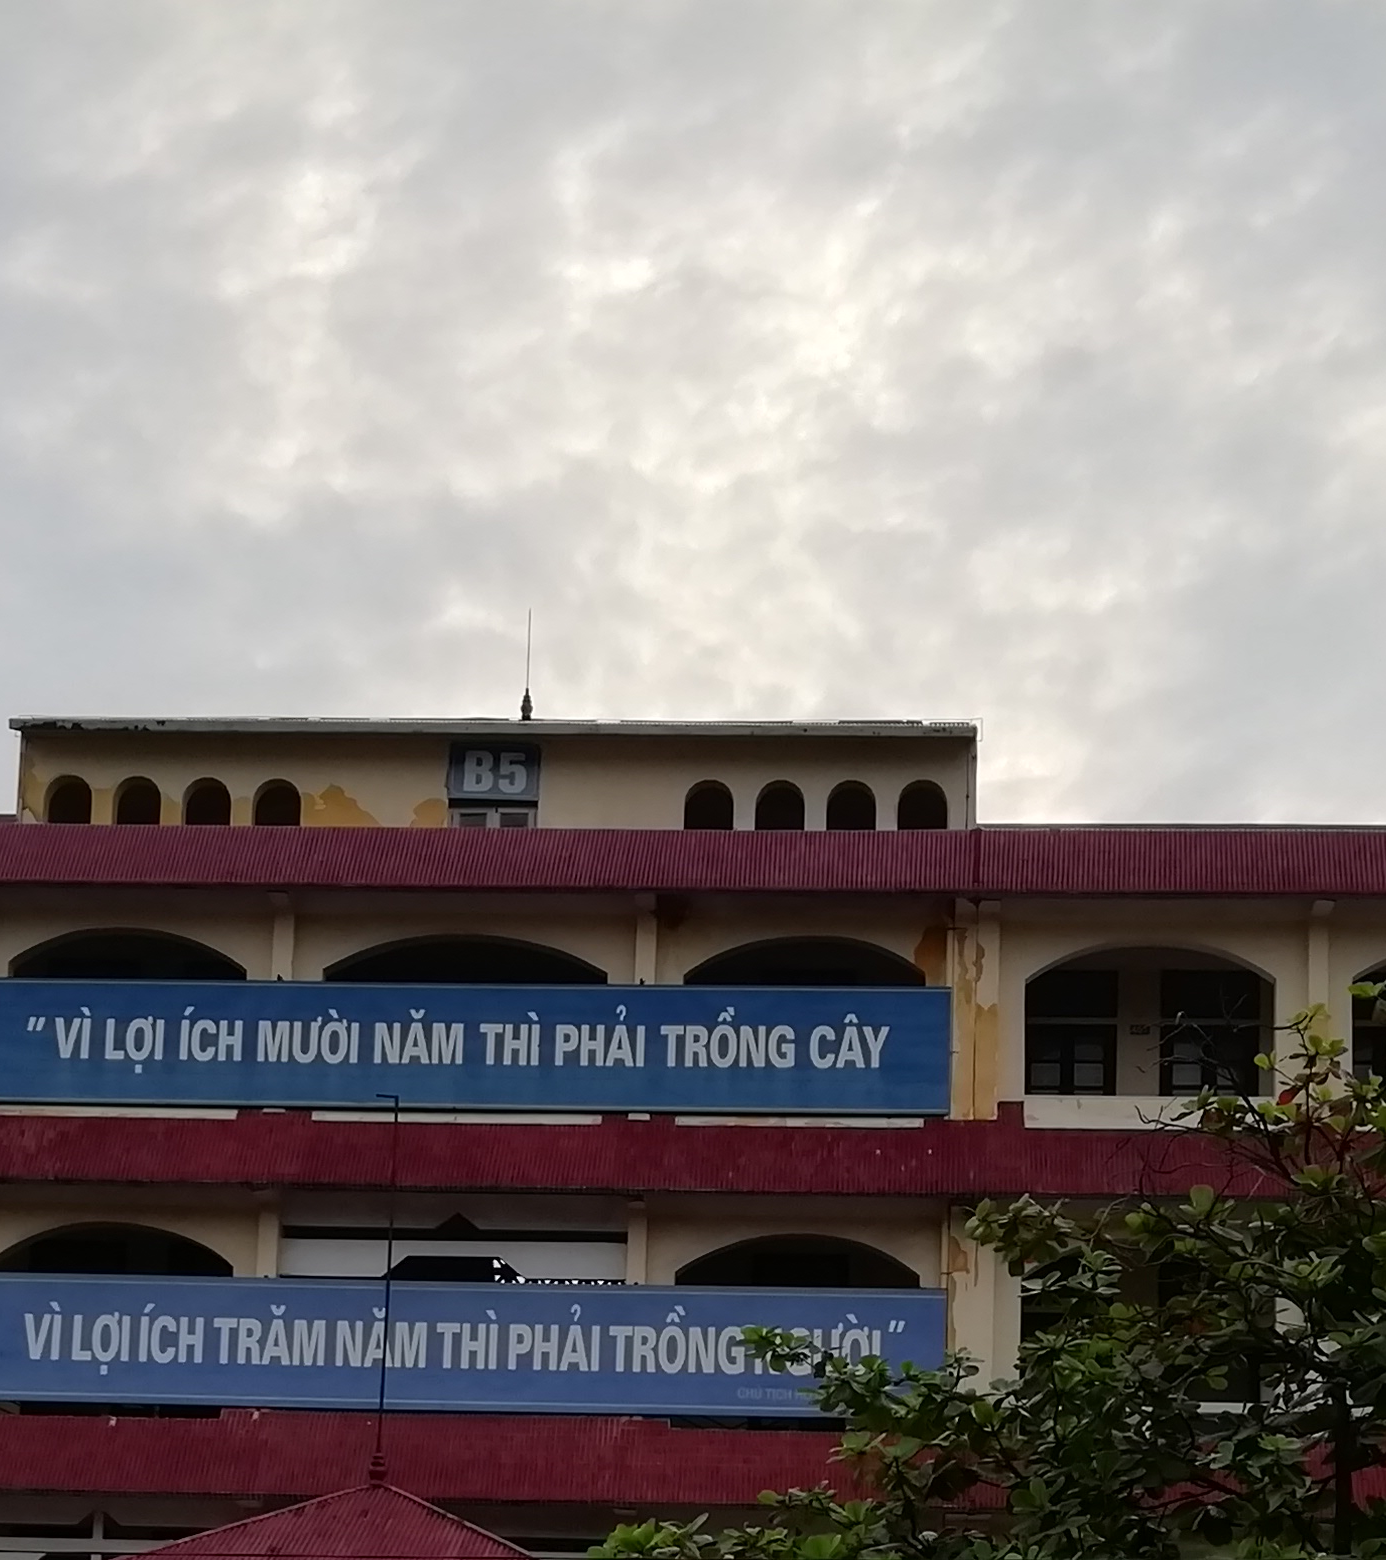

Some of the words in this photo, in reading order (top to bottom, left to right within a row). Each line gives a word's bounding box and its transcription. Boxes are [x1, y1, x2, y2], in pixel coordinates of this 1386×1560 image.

[464, 751, 527, 793] B5
[105, 1015, 166, 1074] LỢI
[179, 1006, 243, 1062] ÍCH
[257, 1008, 360, 1065] MƯỜI
[374, 1008, 464, 1066] NĂM
[479, 1011, 541, 1067] THÌ
[554, 1004, 646, 1068] PHẢI
[660, 1007, 796, 1069] TRỒNG
[809, 1013, 891, 1070] CÂY
[24, 1301, 63, 1361] VÌ
[71, 1311, 131, 1376] LỢI
[138, 1303, 203, 1365] ÍCH
[213, 1305, 327, 1367] TRĂM
[335, 1307, 428, 1369] NĂM
[436, 1309, 498, 1371] THÌ
[508, 1304, 601, 1373] PHẢI
[609, 1305, 745, 1376] TRỒNG
